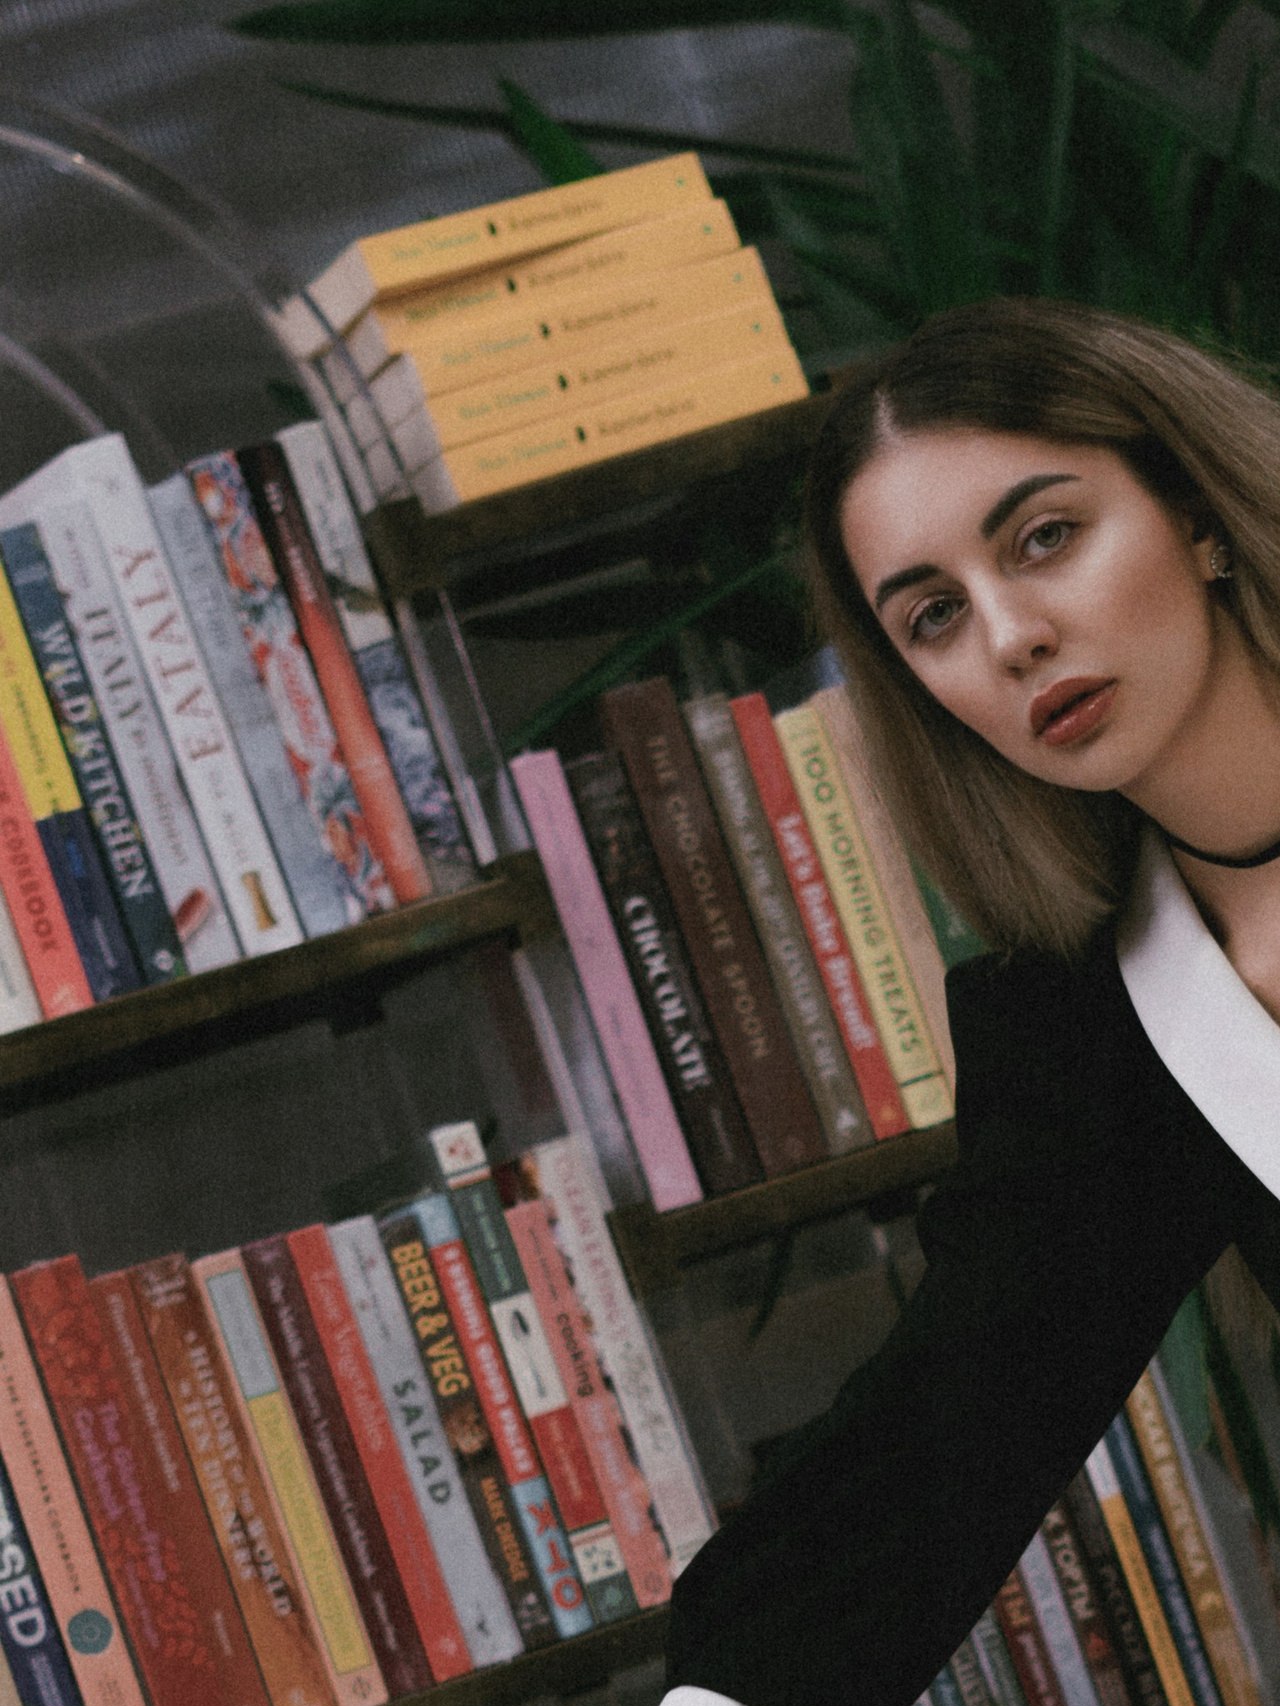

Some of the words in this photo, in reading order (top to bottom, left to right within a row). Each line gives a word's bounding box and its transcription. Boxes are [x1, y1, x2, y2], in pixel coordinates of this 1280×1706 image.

[79, 602, 151, 732] ITALY
[112, 534, 228, 763] EATALY
[34, 619, 96, 725] WILD
[69, 726, 156, 900] KITCHEN
[646, 734, 678, 785] THE
[664, 791, 734, 952] CHOCOLATE
[722, 961, 770, 1061] SPOON
[797, 743, 838, 806] 100
[819, 807, 889, 950] MORNING
[869, 952, 925, 1055] TREATS
[620, 891, 711, 1092] CHOCOLATE
[389, 1240, 440, 1313] BEER
[415, 1310, 450, 1339] &
[424, 1334, 469, 1397] VEG
[551, 1309, 599, 1399] cooking
[96, 1402, 125, 1444] The
[184, 1401, 214, 1450] TEN
[185, 1344, 241, 1461] HISTORY
[244, 1518, 294, 1619] WORLD
[390, 1375, 457, 1509] SALAD
